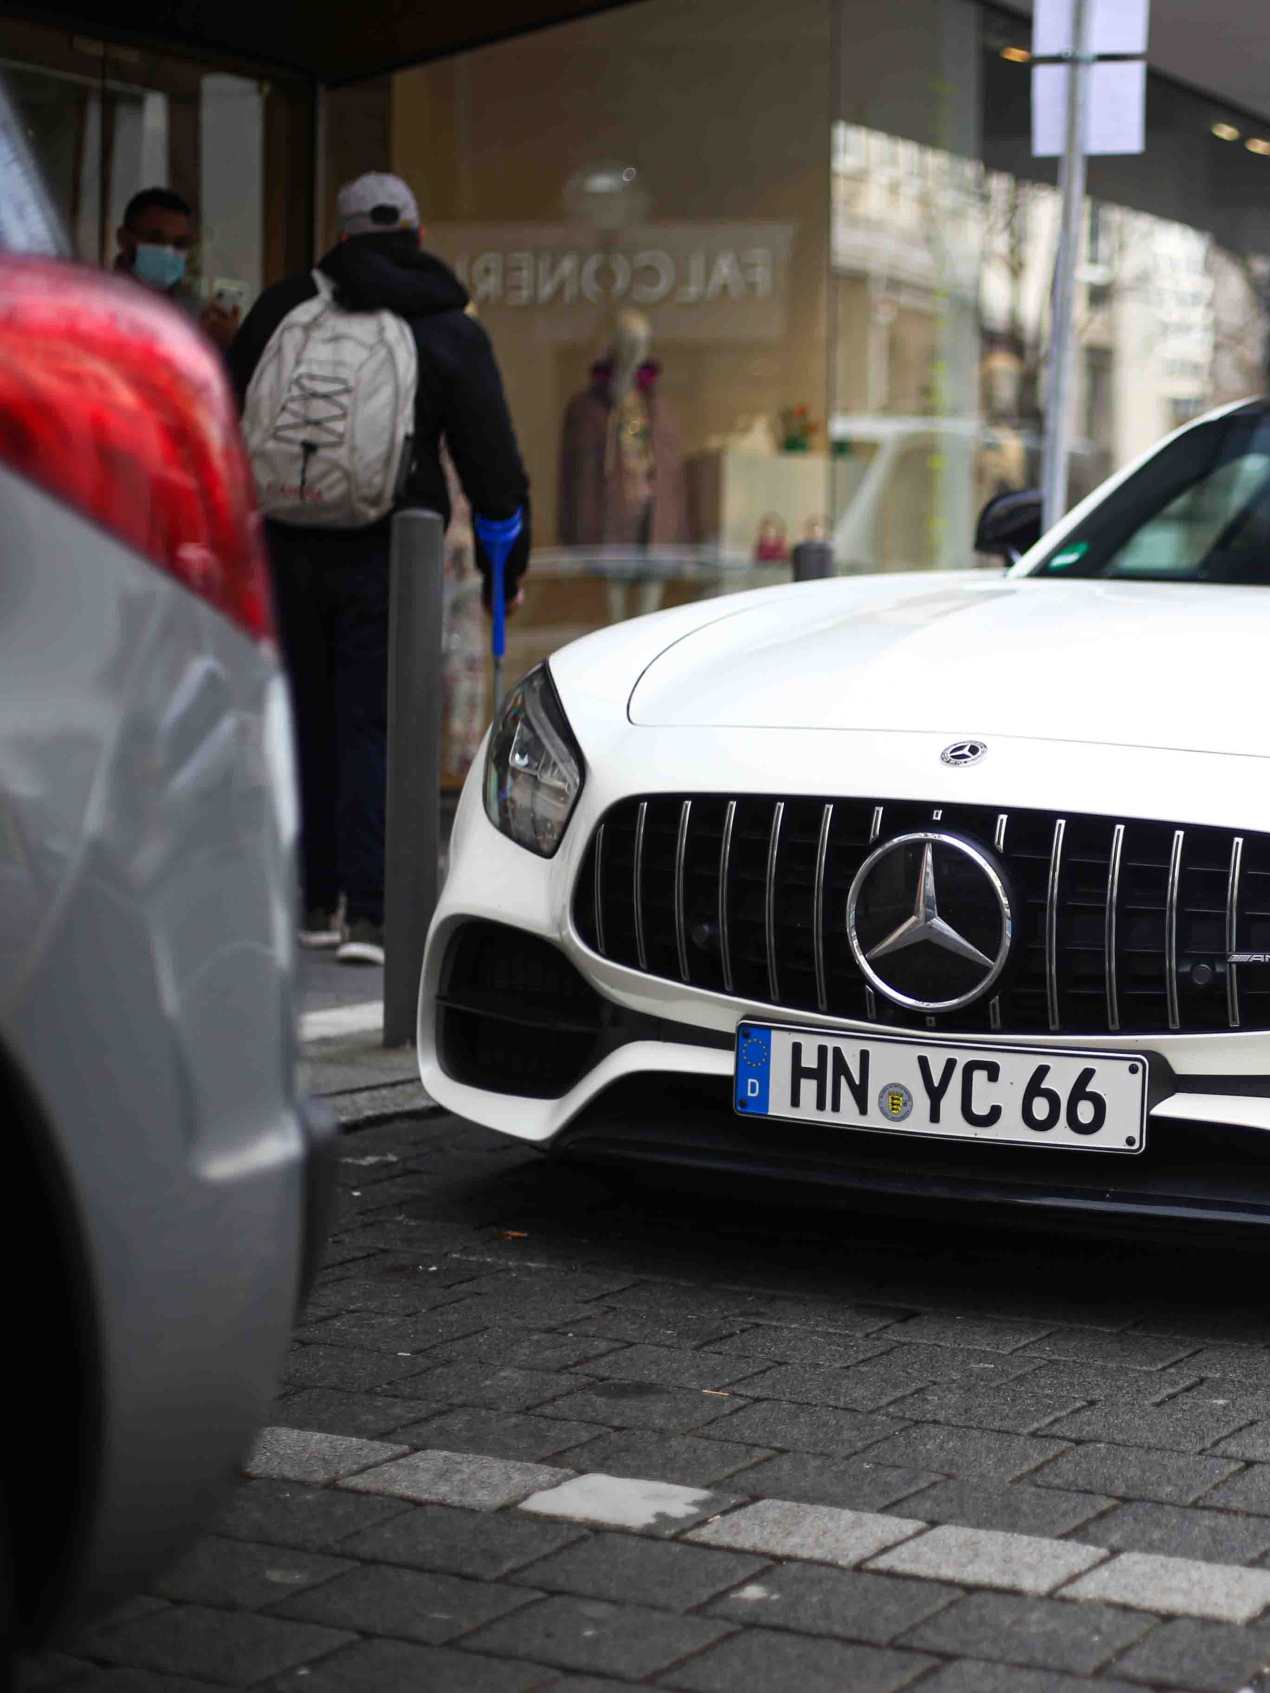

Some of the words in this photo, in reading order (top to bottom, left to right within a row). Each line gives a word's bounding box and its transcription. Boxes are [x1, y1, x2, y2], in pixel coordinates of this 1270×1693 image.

[747, 1078, 760, 1097] D
[789, 1041, 870, 1116] HN
[917, 1054, 1003, 1128] YC
[1021, 1063, 1107, 1135] 66
